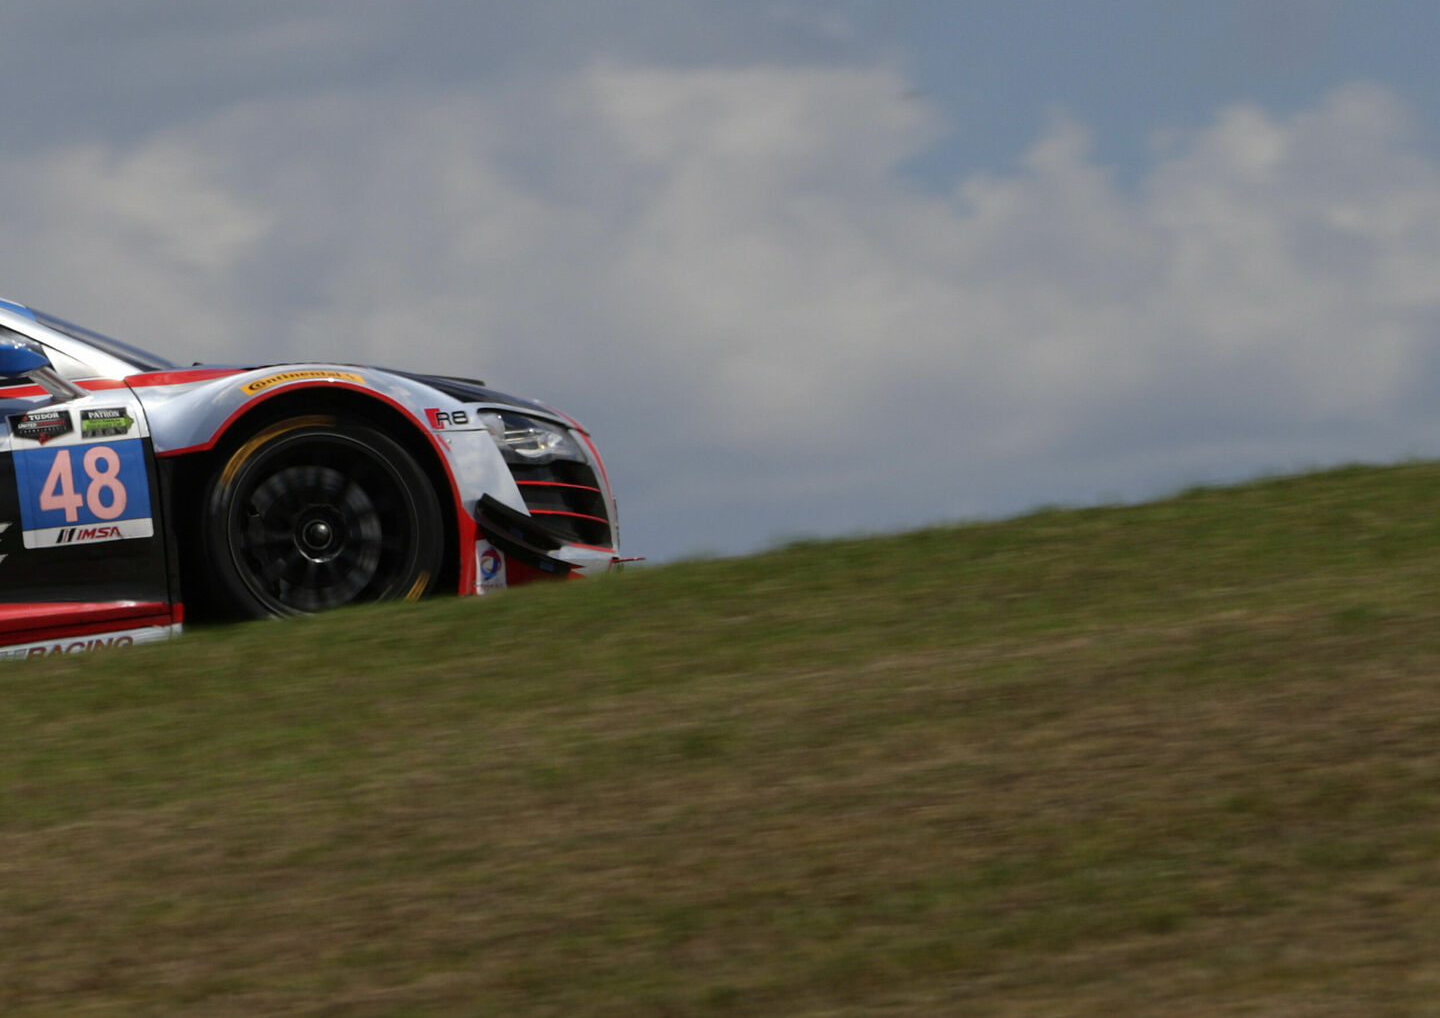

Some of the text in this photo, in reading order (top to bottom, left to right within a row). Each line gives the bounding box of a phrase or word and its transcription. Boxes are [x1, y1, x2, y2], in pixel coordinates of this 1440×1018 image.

[29, 412, 60, 421] TUDOR
[435, 411, 469, 425] R8
[40, 446, 127, 523] 48
[76, 525, 123, 541] IMSA
